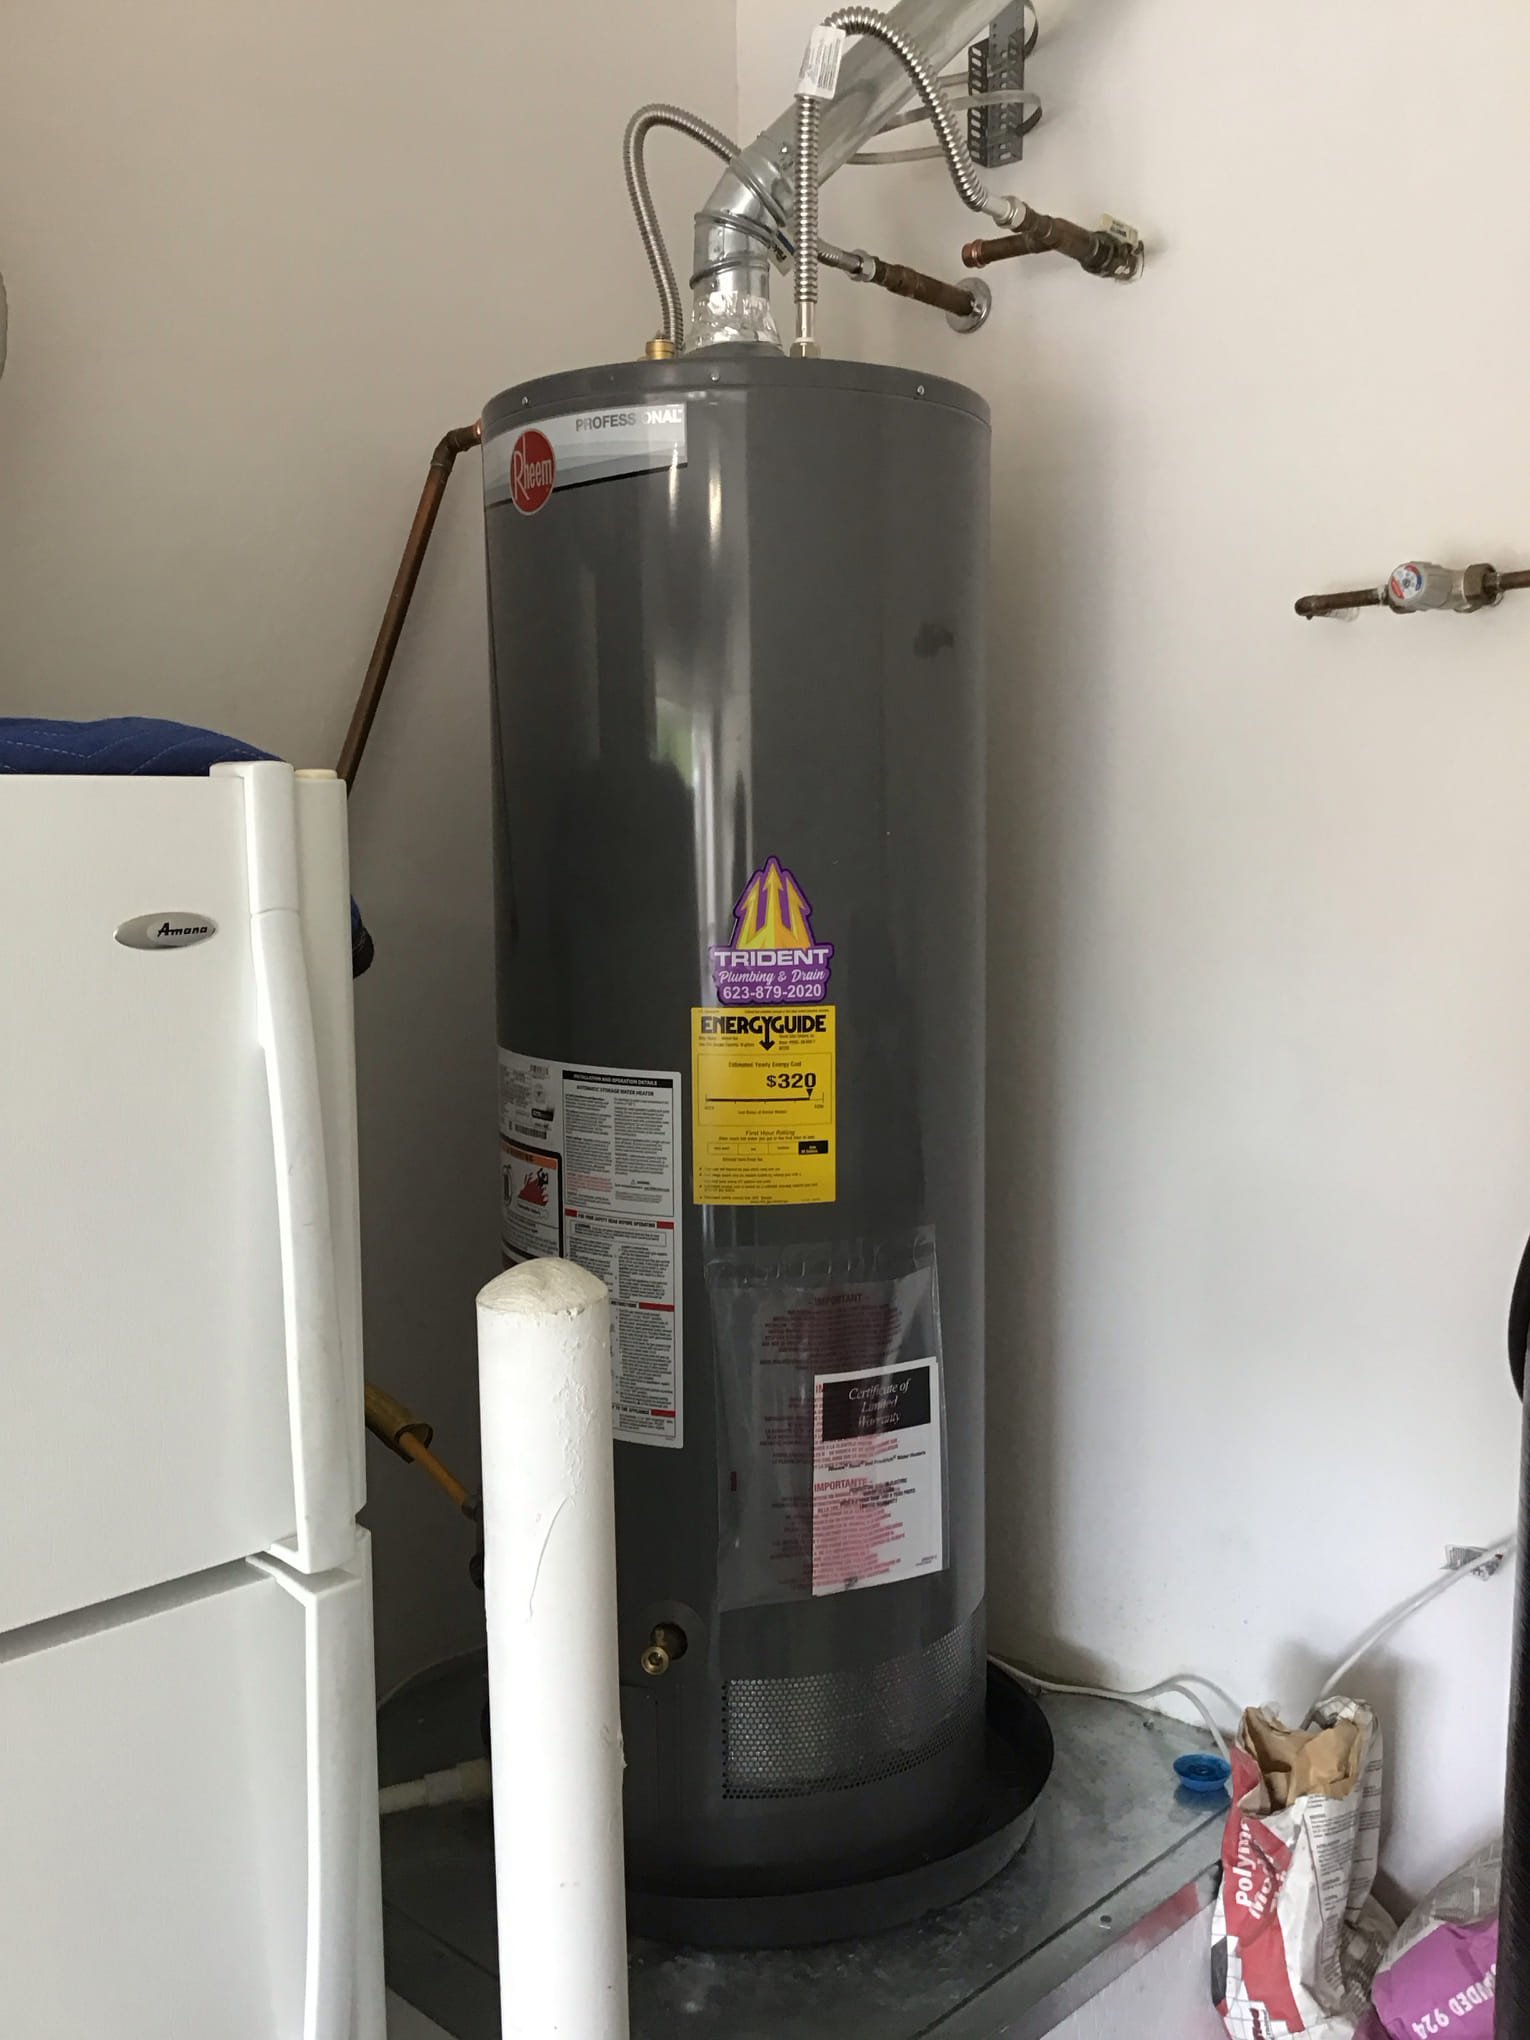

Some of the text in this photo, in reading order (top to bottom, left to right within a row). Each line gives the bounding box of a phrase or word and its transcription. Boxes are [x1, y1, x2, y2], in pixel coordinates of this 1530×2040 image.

[576, 408, 682, 431] PROFESSONAL
[513, 434, 552, 500] Rheem
[157, 921, 208, 937] Amana
[714, 949, 829, 967] TRIDENT
[718, 968, 825, 985] Plumbing & Drain
[723, 984, 822, 999] 623-879-2020
[766, 1072, 816, 1089] $320
[848, 1378, 911, 1400] Certificate of
[1411, 1963, 1496, 2040] ANDED 924
